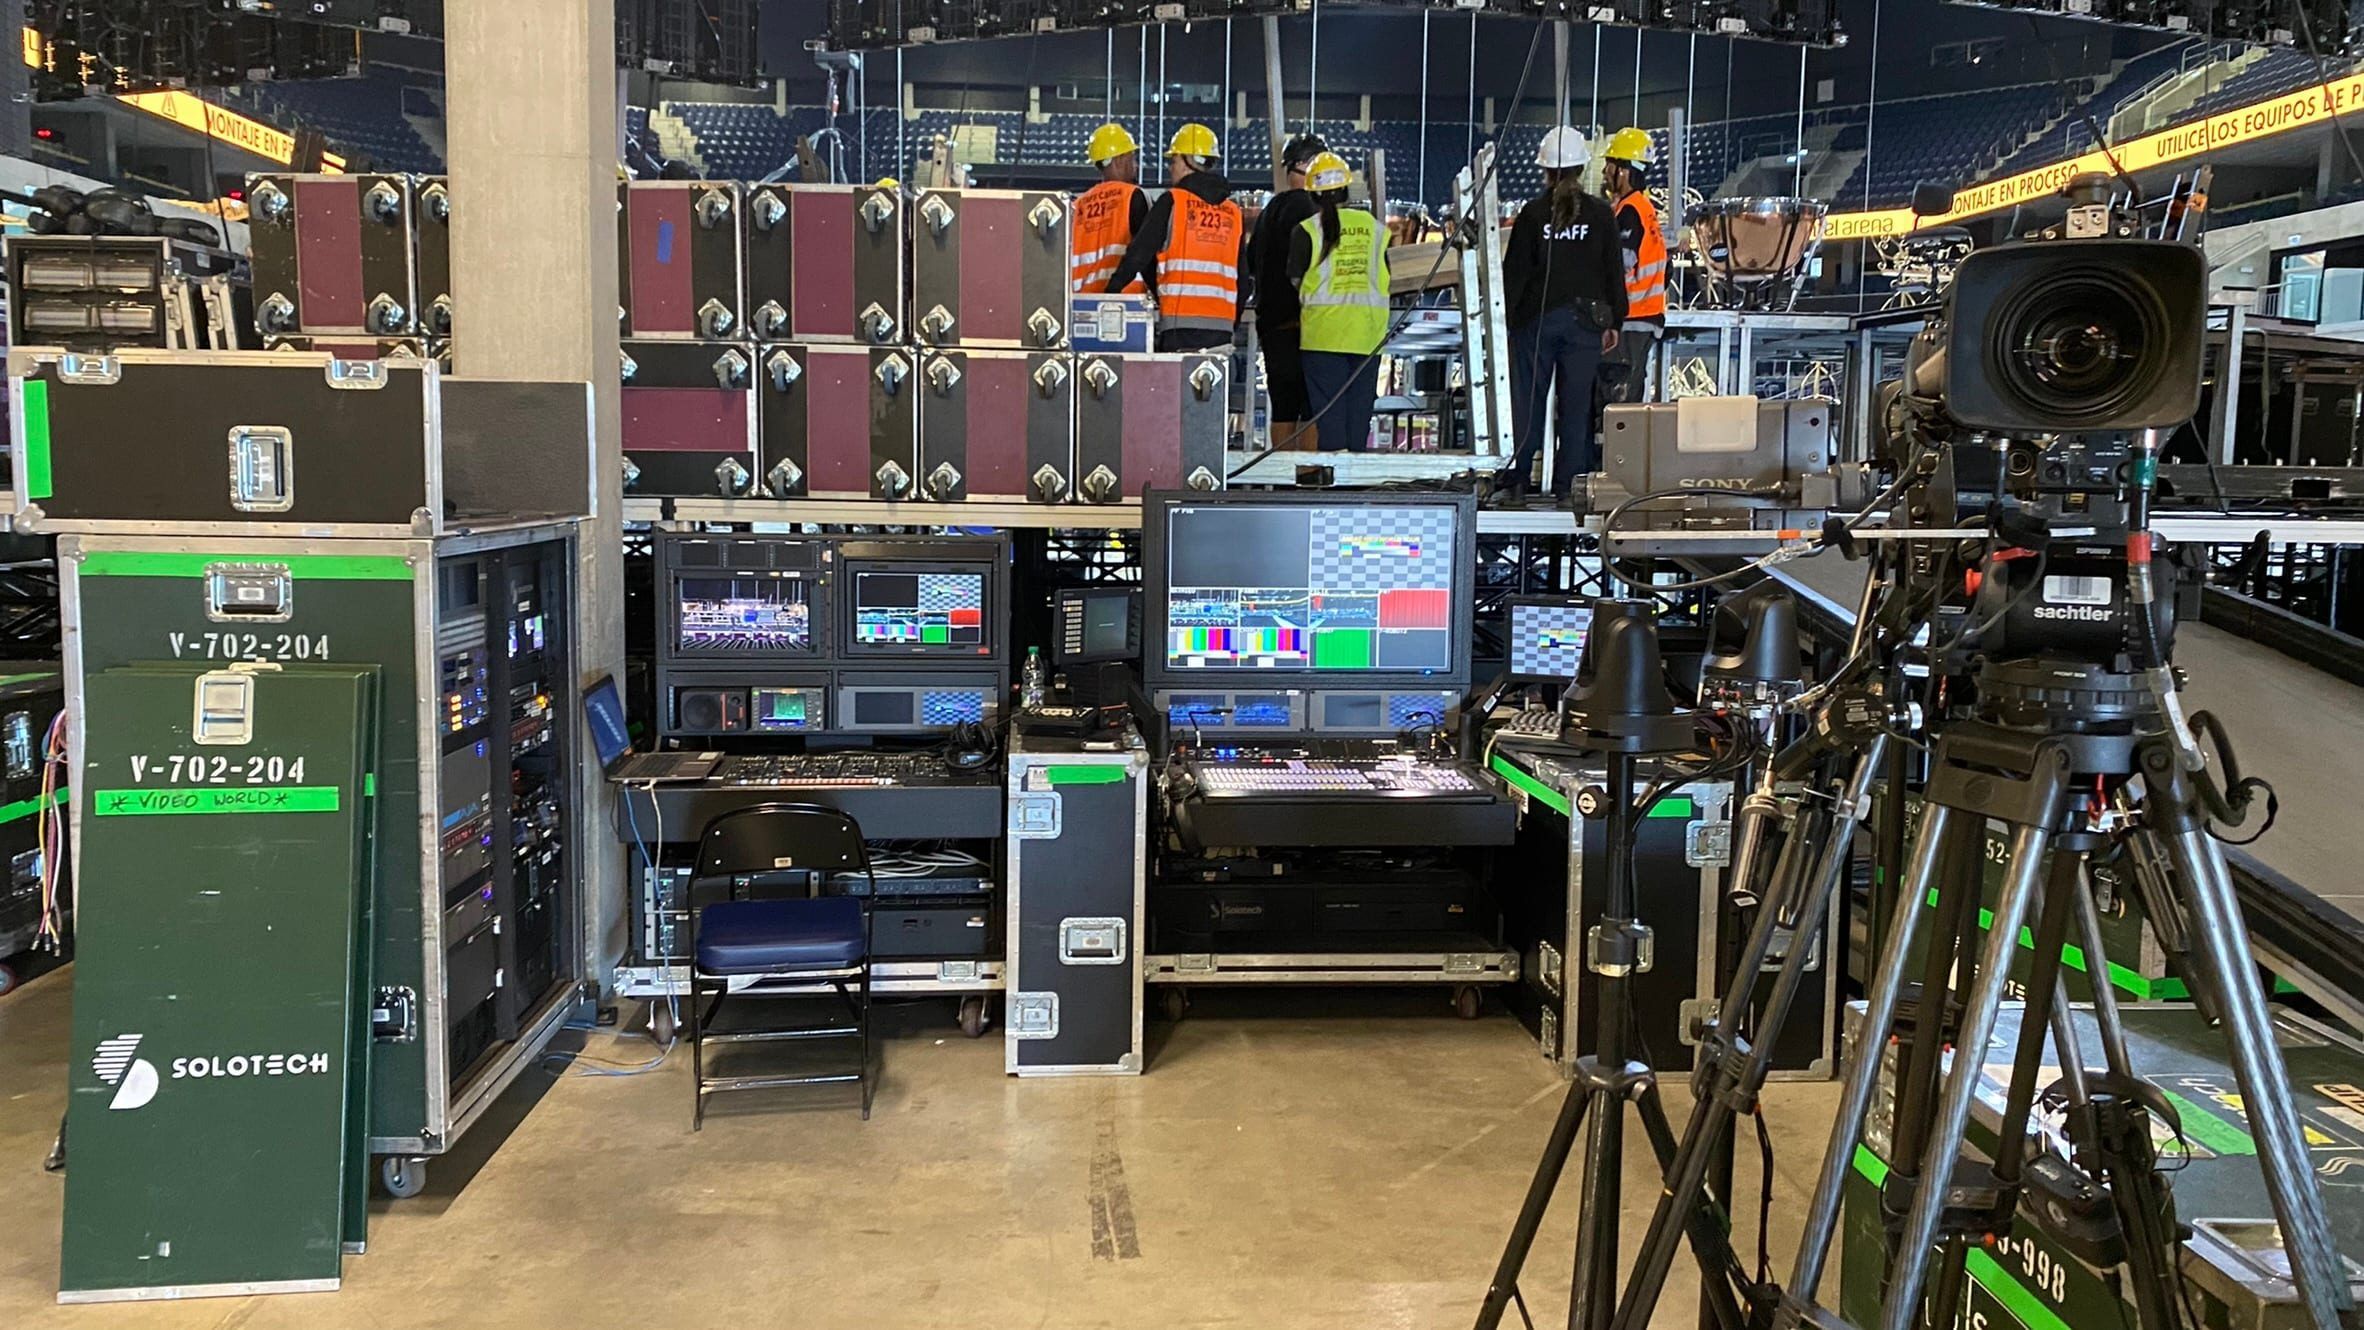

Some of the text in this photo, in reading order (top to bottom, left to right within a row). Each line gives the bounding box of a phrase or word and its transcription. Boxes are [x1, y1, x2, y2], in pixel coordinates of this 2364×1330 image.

[2157, 128, 2205, 158] UTILICE
[2211, 121, 2238, 143] LOS
[2244, 96, 2316, 134] EQUIPOS
[264, 131, 279, 156] EN
[1946, 163, 2079, 216] ONTAJE EN PROCESO
[1200, 210, 1221, 230] 223
[1842, 217, 1893, 236] arena
[1679, 478, 1754, 490] SONY
[2033, 605, 2114, 622] sachtler
[169, 632, 329, 660] V-702-204
[130, 755, 305, 784] V-702-204
[139, 791, 199, 809] VIDEO
[171, 1052, 329, 1079] SOLOTECH
